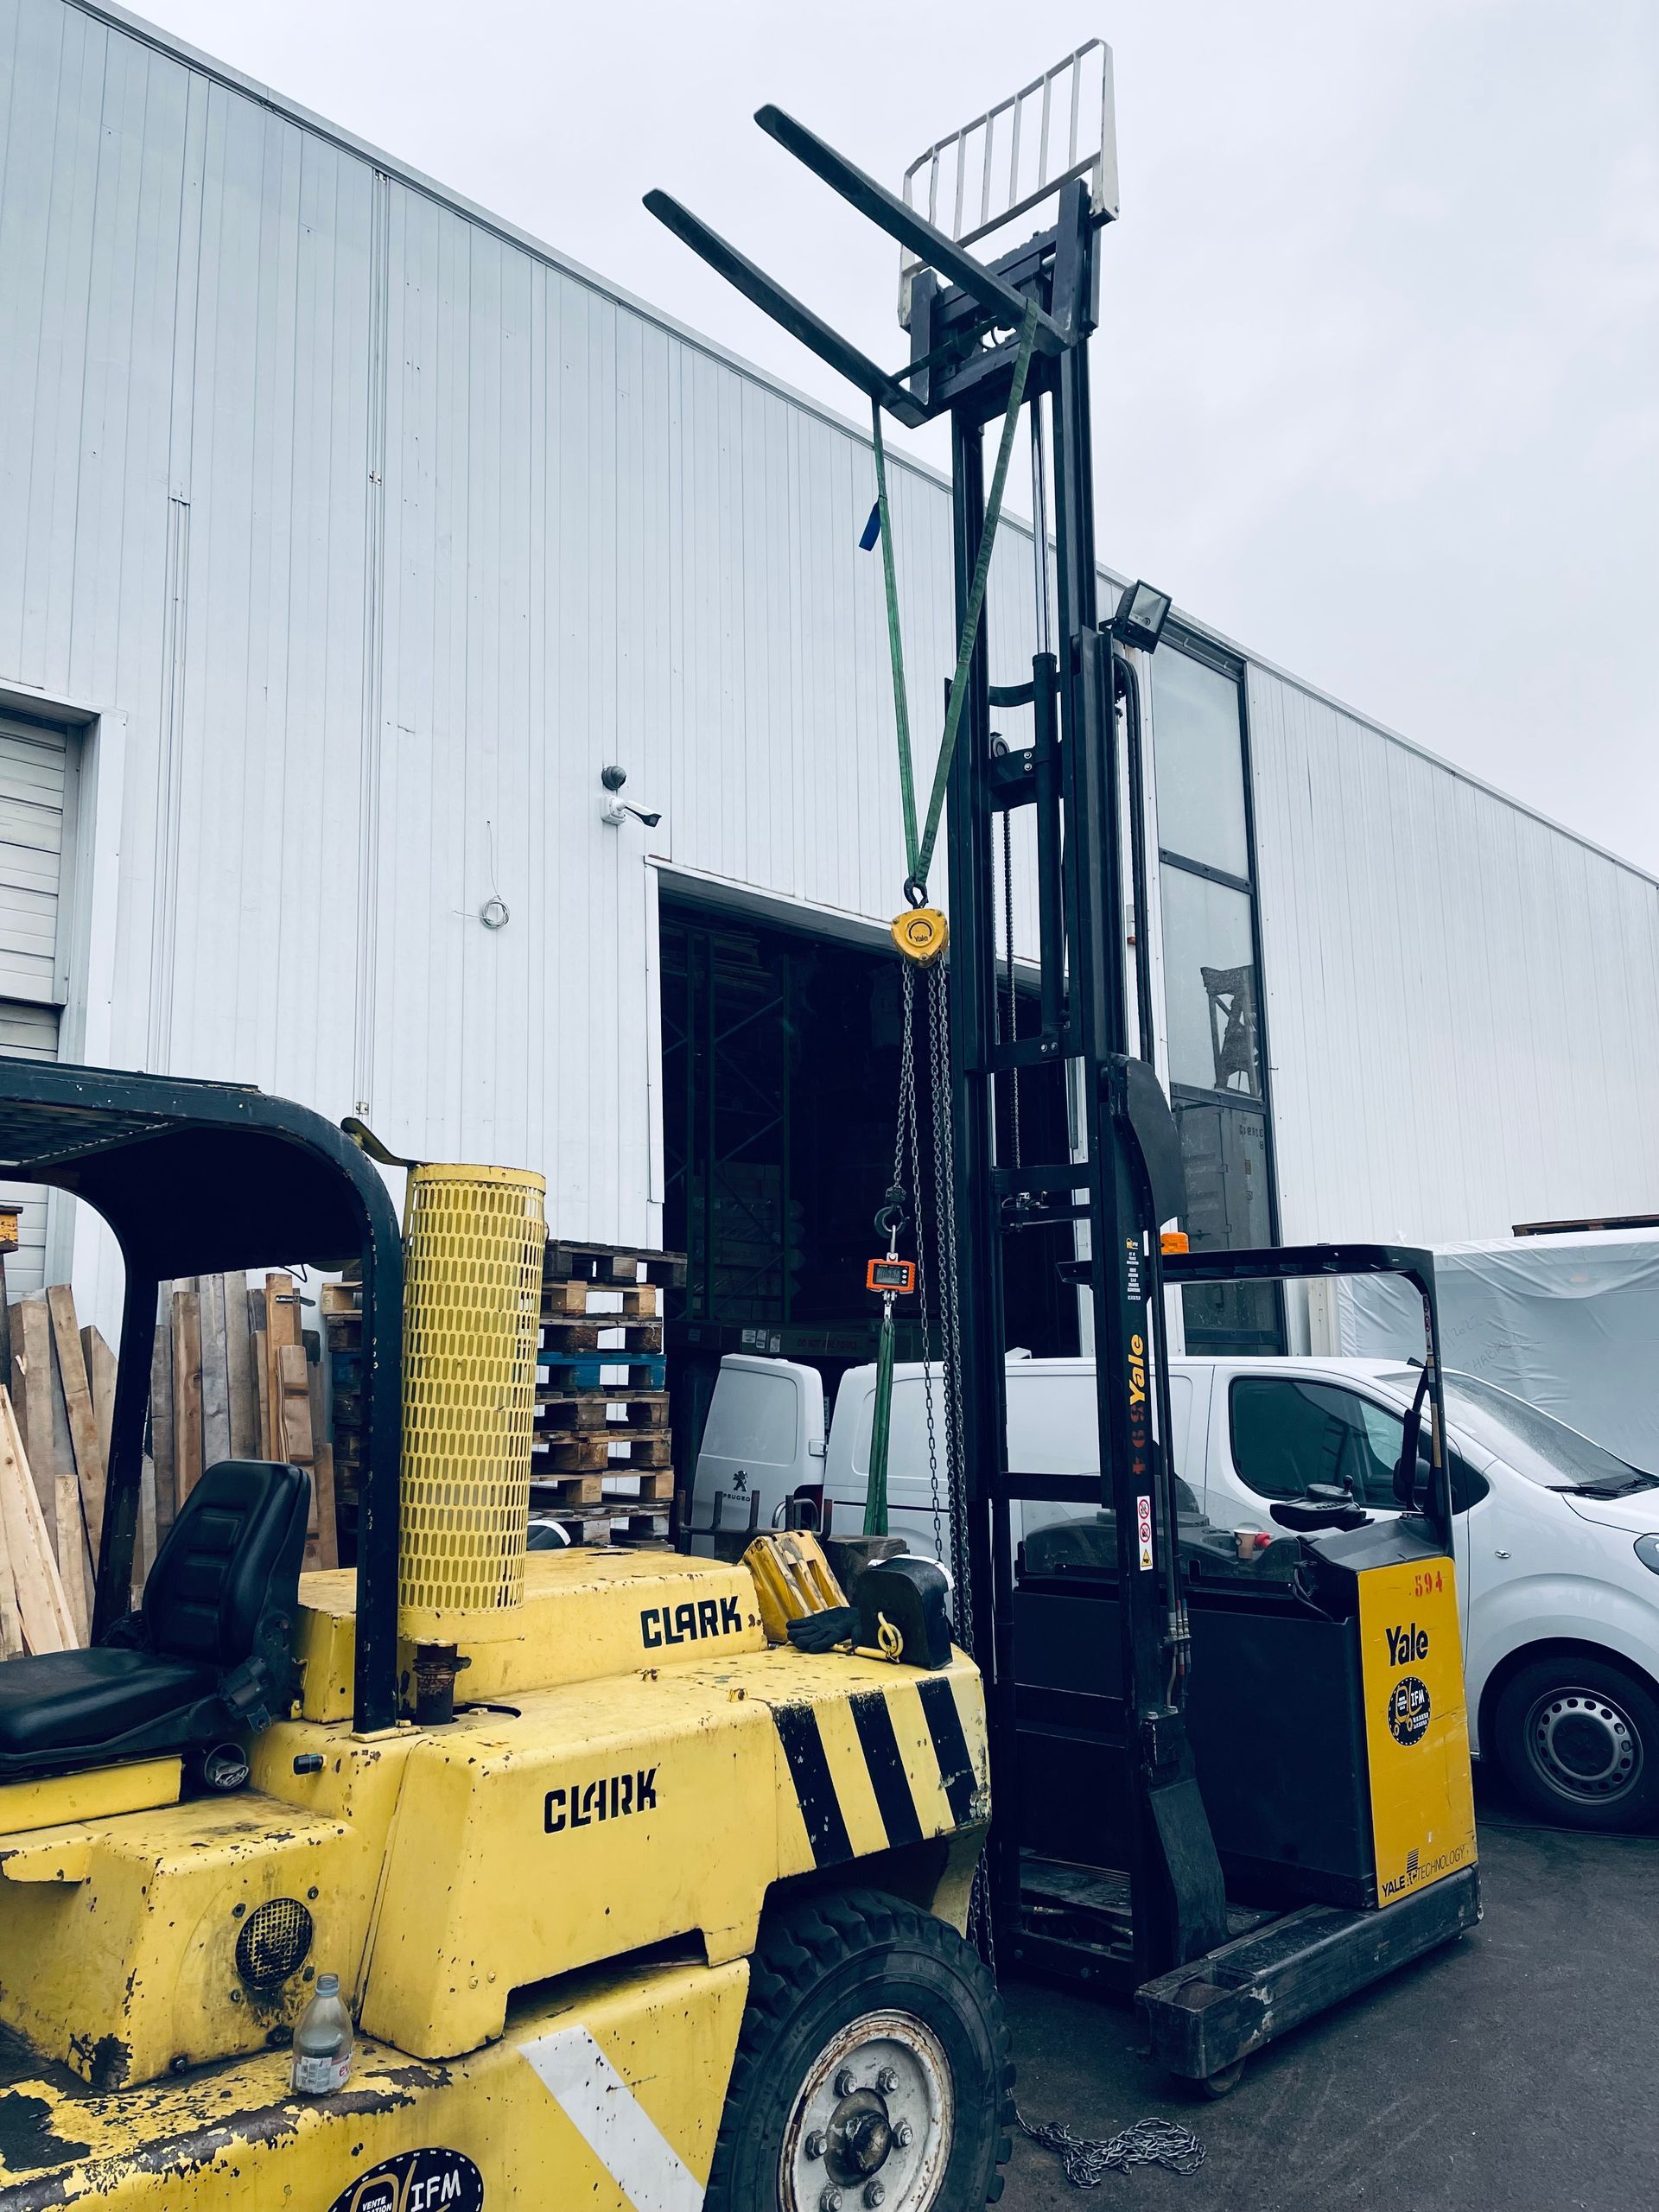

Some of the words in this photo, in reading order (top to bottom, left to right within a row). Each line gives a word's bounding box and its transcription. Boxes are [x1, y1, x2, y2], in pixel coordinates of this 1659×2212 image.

[917, 830, 937, 882] NNES
[913, 934, 929, 943] Yale
[1128, 1333, 1146, 1405] Yale
[722, 1492, 751, 1502] PEUGEO
[1414, 1571, 1443, 1597] 594
[640, 1596, 742, 1649] CLARK
[1385, 1623, 1429, 1667] Yale
[1410, 1689, 1425, 1707] IFM
[543, 1766, 658, 1834] CLARK
[1382, 1874, 1406, 1897] YALE
[1417, 1844, 1465, 1882] TECHNOLOGY
[362, 2196, 387, 2212] VENTE
[410, 2169, 461, 2212] IFM
